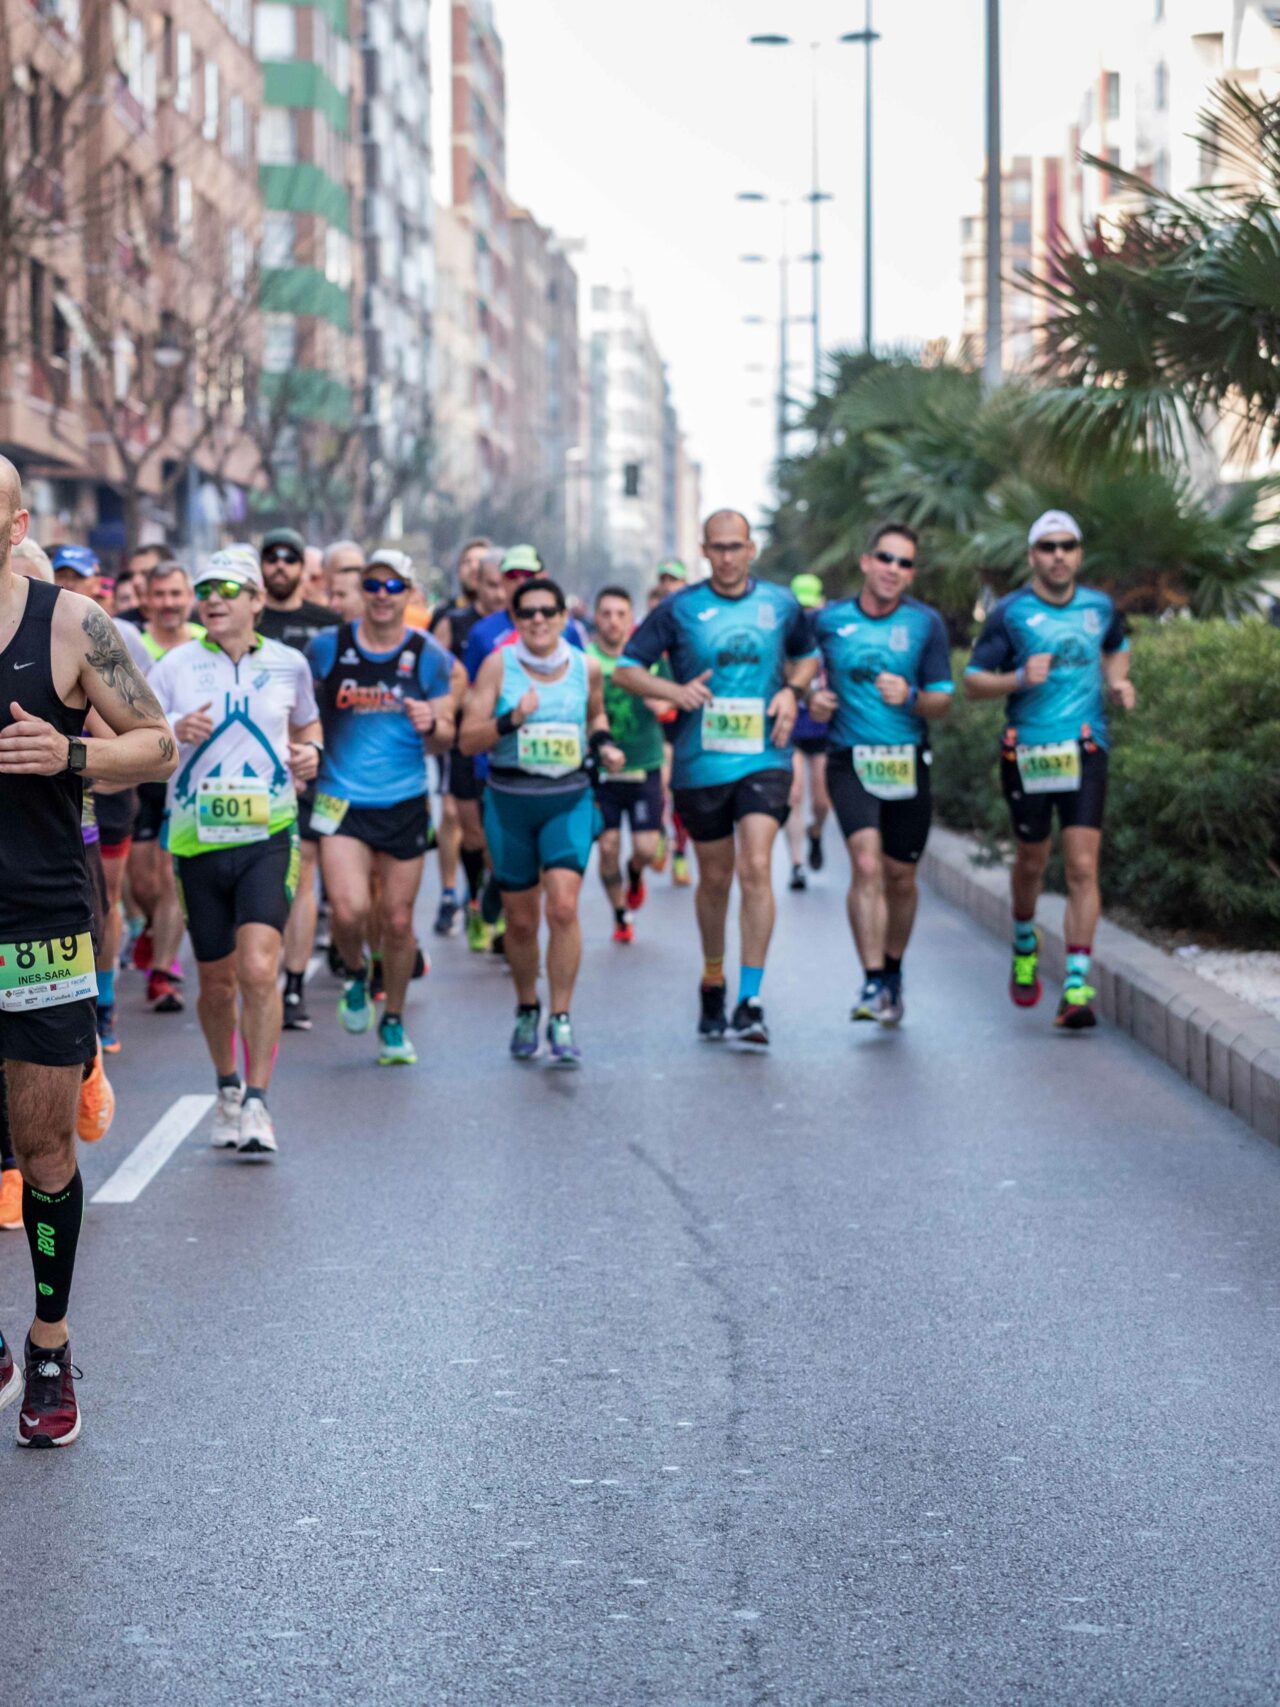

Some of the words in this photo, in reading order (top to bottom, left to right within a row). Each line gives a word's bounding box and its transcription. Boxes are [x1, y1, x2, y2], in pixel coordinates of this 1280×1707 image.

[717, 714, 752, 732] 937
[531, 739, 576, 757] 1126
[865, 760, 909, 778] 1068
[211, 798, 253, 818] 601
[15, 935, 78, 969] 819
[18, 968, 72, 985] INES-SARA
